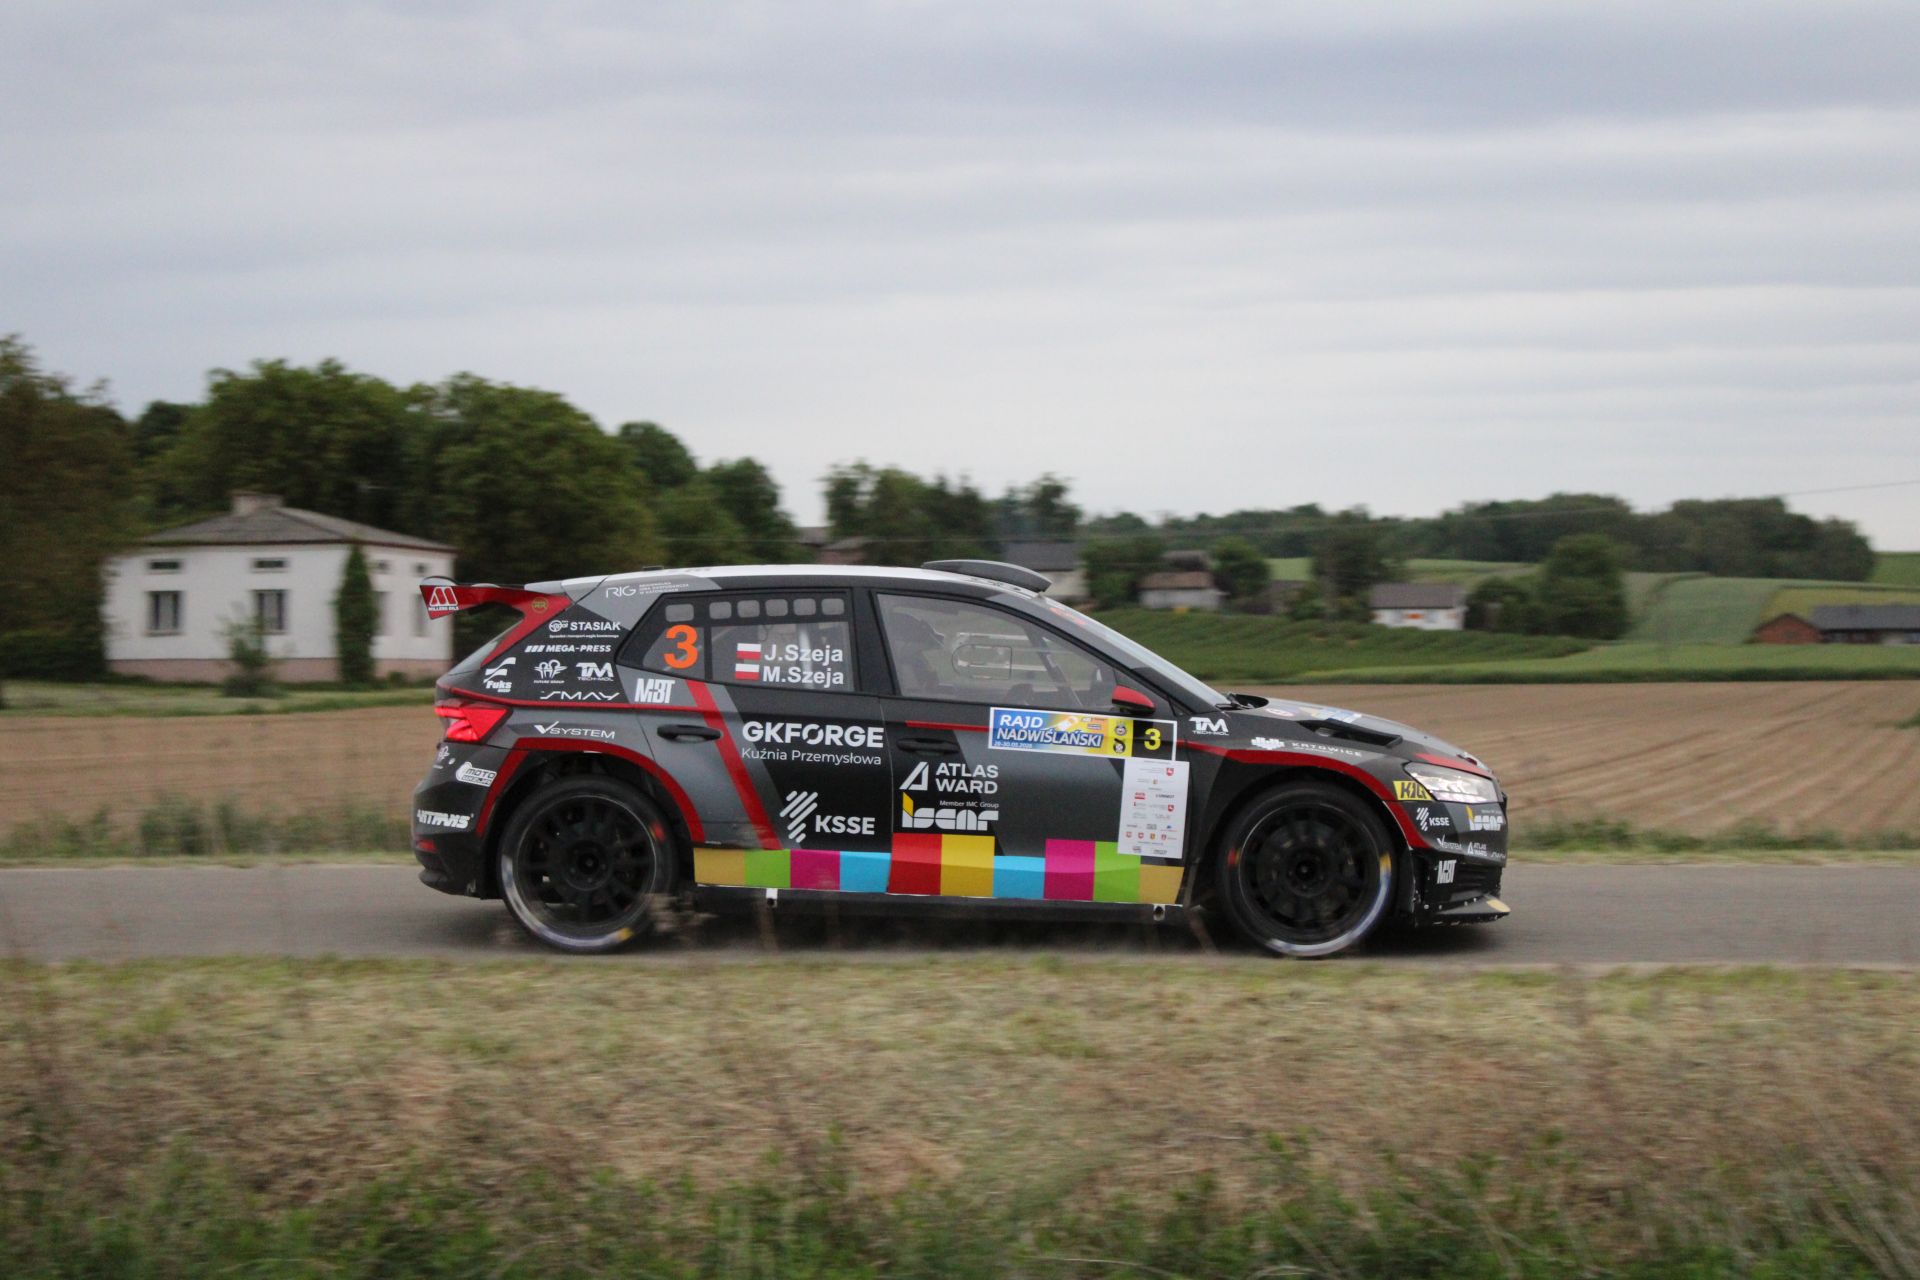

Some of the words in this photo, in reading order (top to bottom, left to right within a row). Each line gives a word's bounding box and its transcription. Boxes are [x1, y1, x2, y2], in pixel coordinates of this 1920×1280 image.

[606, 585, 637, 598] RIG
[570, 621, 621, 631] STASIAK
[545, 644, 612, 653] MEGA-PRESS
[664, 624, 698, 669] 3
[763, 645, 843, 666] J.Szeja
[576, 662, 614, 678] TM
[763, 666, 844, 688] M.Szeja
[486, 680, 512, 689] Fuks
[1000, 714, 1043, 729] RAJD
[1189, 716, 1229, 732] TM
[742, 720, 884, 748] GKFORGE
[997, 728, 1102, 747] NADWIŚLAŃSKI
[1143, 728, 1161, 750] 3
[741, 747, 788, 761] Kuźnia
[791, 750, 882, 766] Przemysłowa
[466, 768, 496, 779] MOTO
[935, 762, 999, 779] ATLAS
[935, 778, 998, 794] WARD
[815, 814, 876, 835] KSSE
[1429, 817, 1450, 827] KSSE
